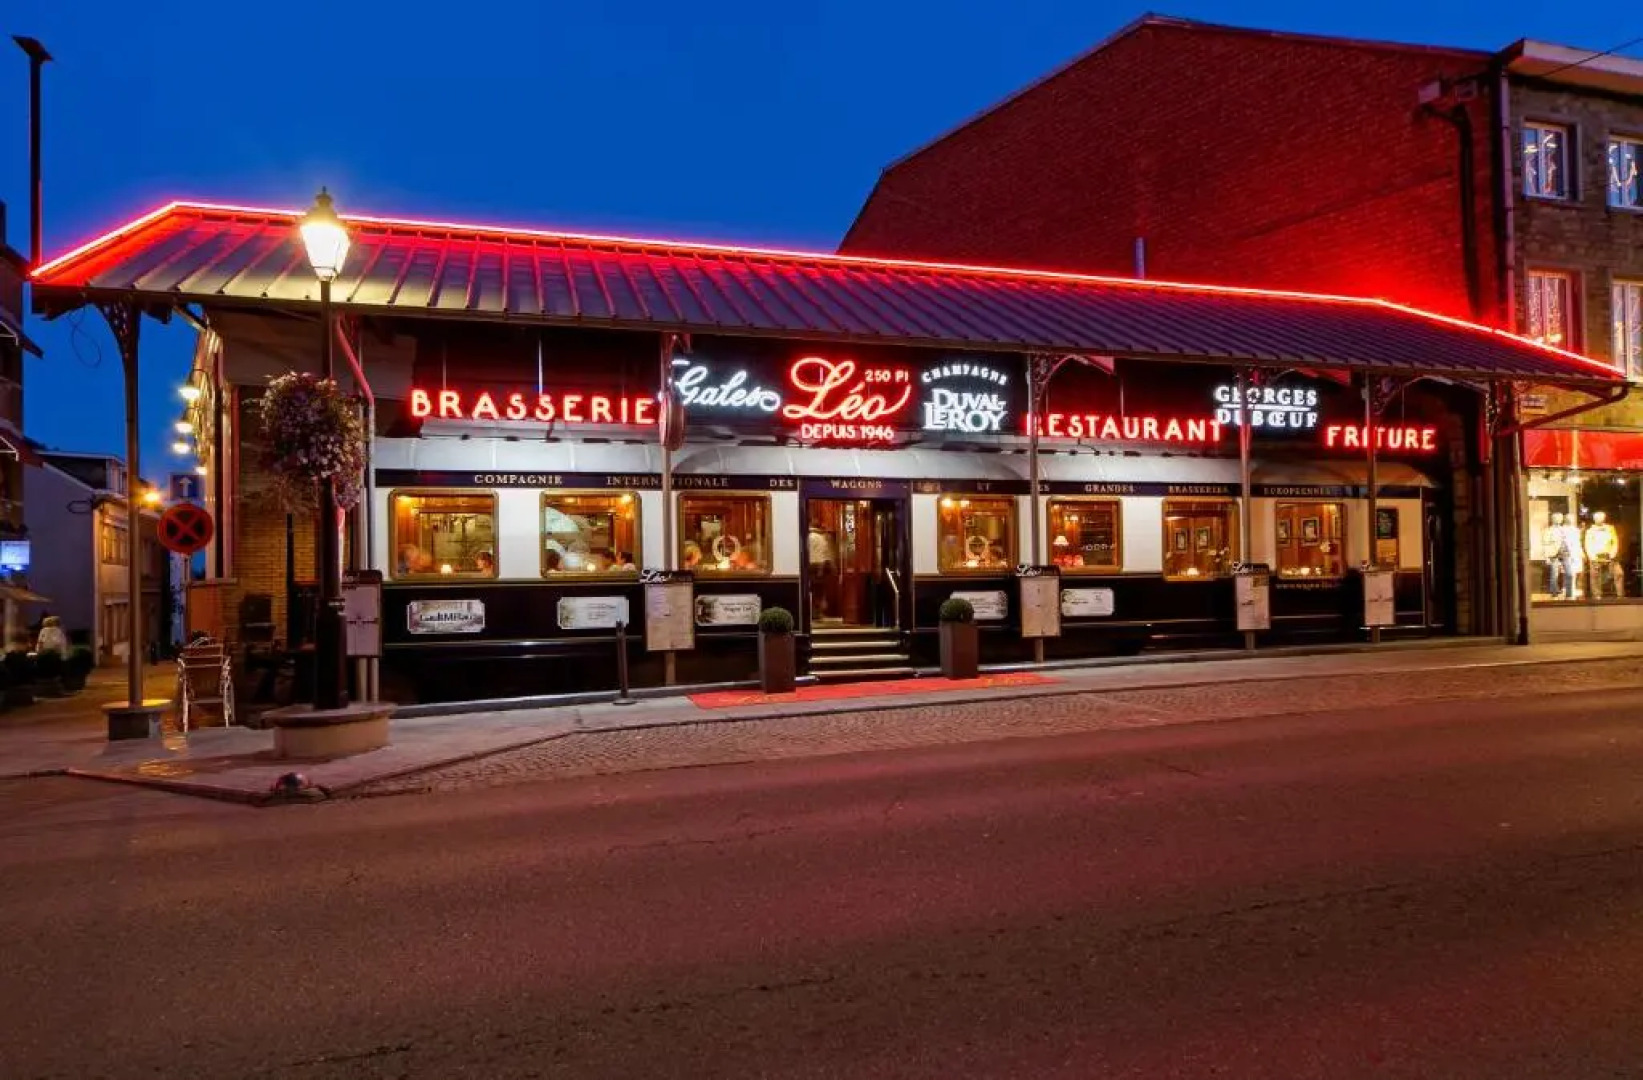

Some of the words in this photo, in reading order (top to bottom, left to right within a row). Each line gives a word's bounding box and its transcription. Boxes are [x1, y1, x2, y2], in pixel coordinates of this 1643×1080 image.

[865, 369, 891, 382] 250
[922, 364, 1007, 385] CHAMPAGNE
[783, 357, 911, 420] Léo
[411, 389, 655, 424] BRASSERIE
[921, 401, 1008, 432] LEROY
[801, 423, 856, 438] DEPUIS
[861, 425, 895, 439] 1946
[1327, 426, 1436, 450] FRITURE
[474, 474, 562, 484] COMPAGNIE
[769, 478, 794, 487] DES
